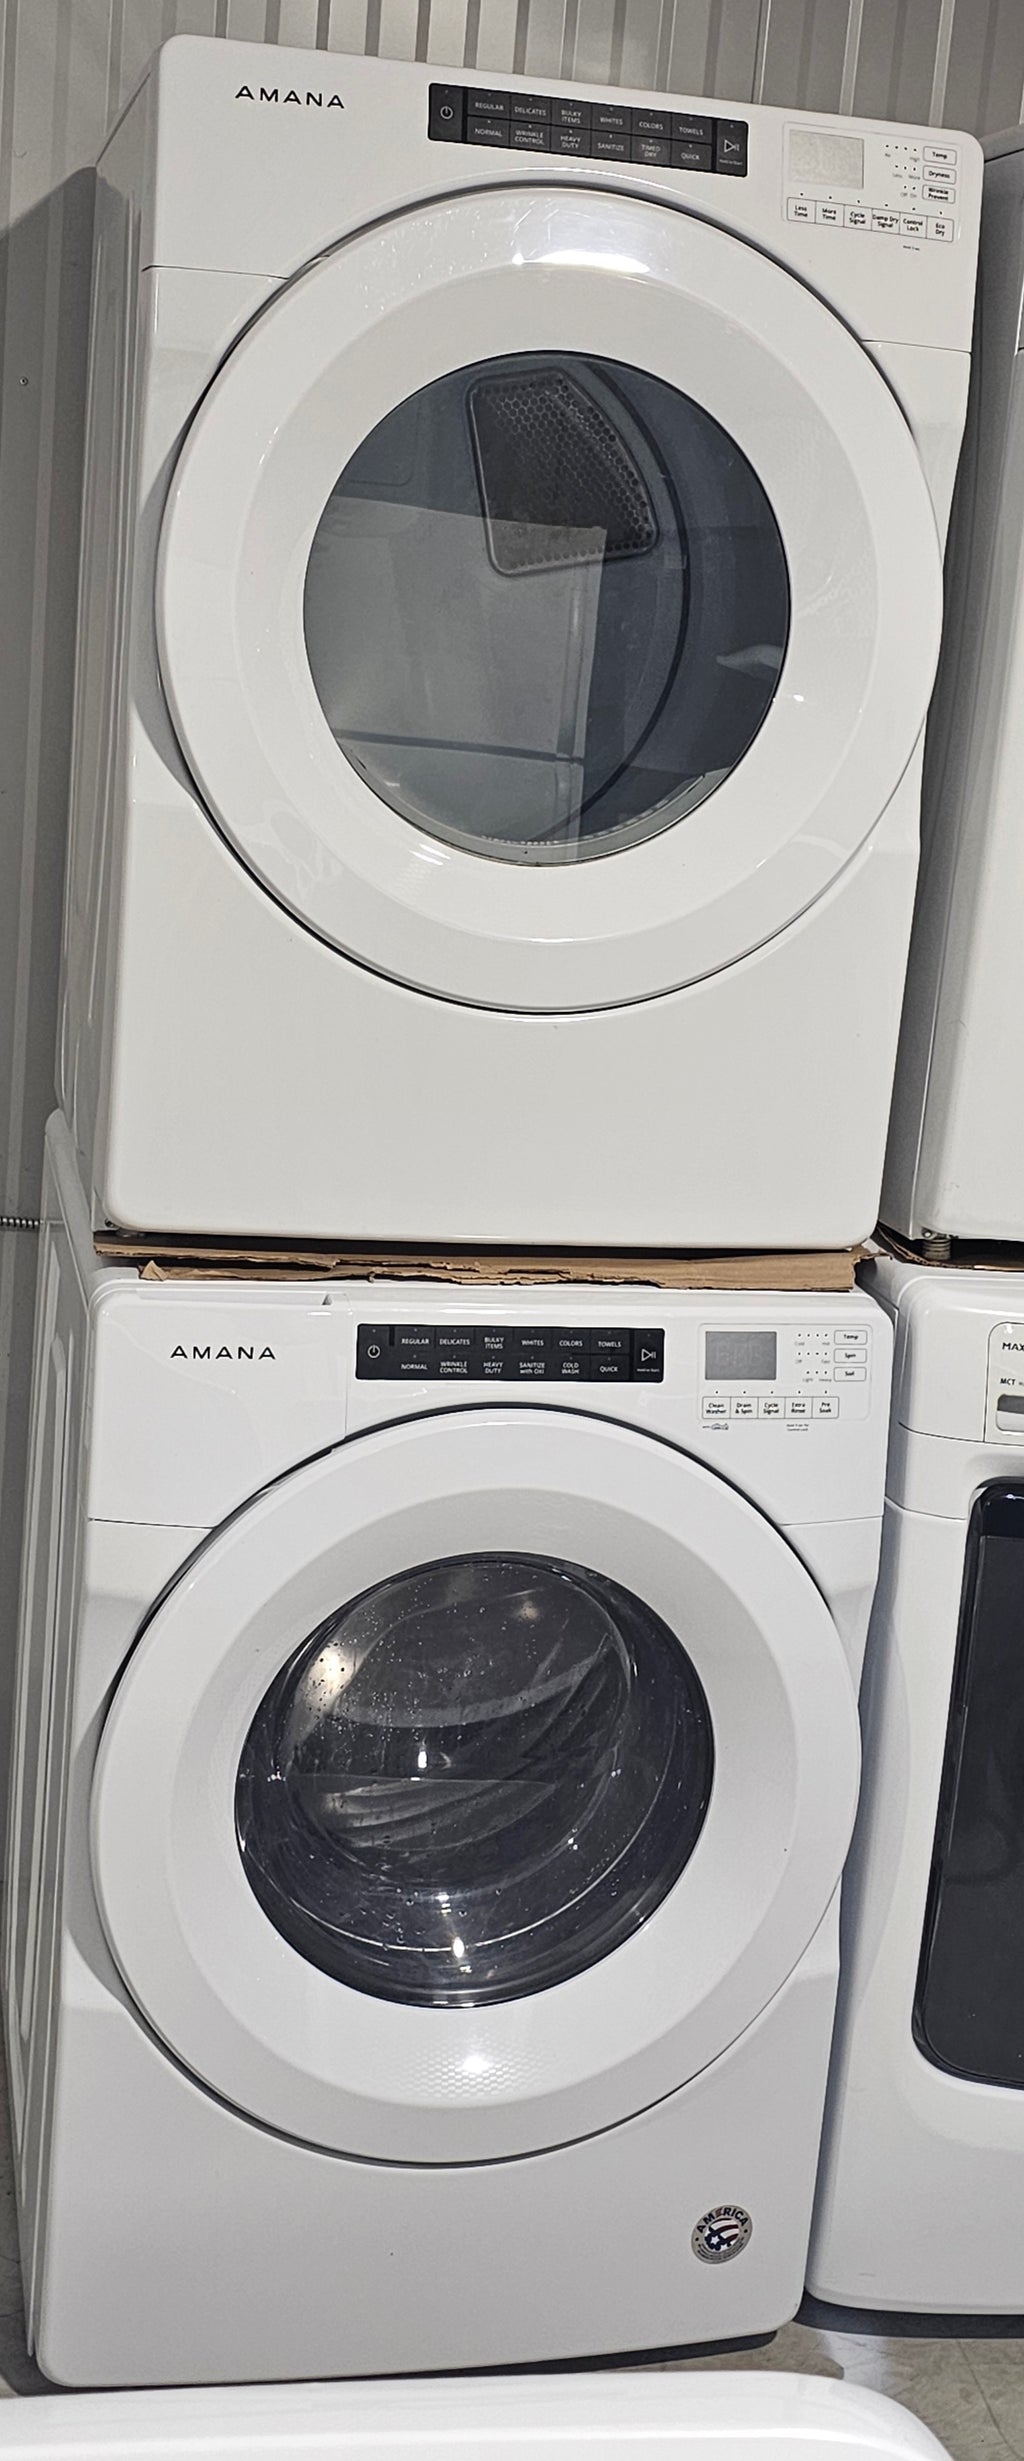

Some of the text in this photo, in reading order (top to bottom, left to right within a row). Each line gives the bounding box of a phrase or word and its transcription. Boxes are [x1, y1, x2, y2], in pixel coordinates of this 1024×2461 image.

[235, 86, 344, 108] AMANA
[475, 102, 504, 110] REGULAR
[514, 106, 546, 116] DELICATES
[600, 117, 622, 126] WHITES
[639, 121, 663, 130] COLORS
[475, 128, 502, 137] NORMAL
[516, 130, 544, 138] WRINKLE
[679, 127, 704, 136] TOWELS
[515, 137, 544, 145] CONTROL
[598, 143, 624, 151] SANITIZE
[170, 1346, 276, 1360] AMANA
[697, 2208, 748, 2233] AMERICA
